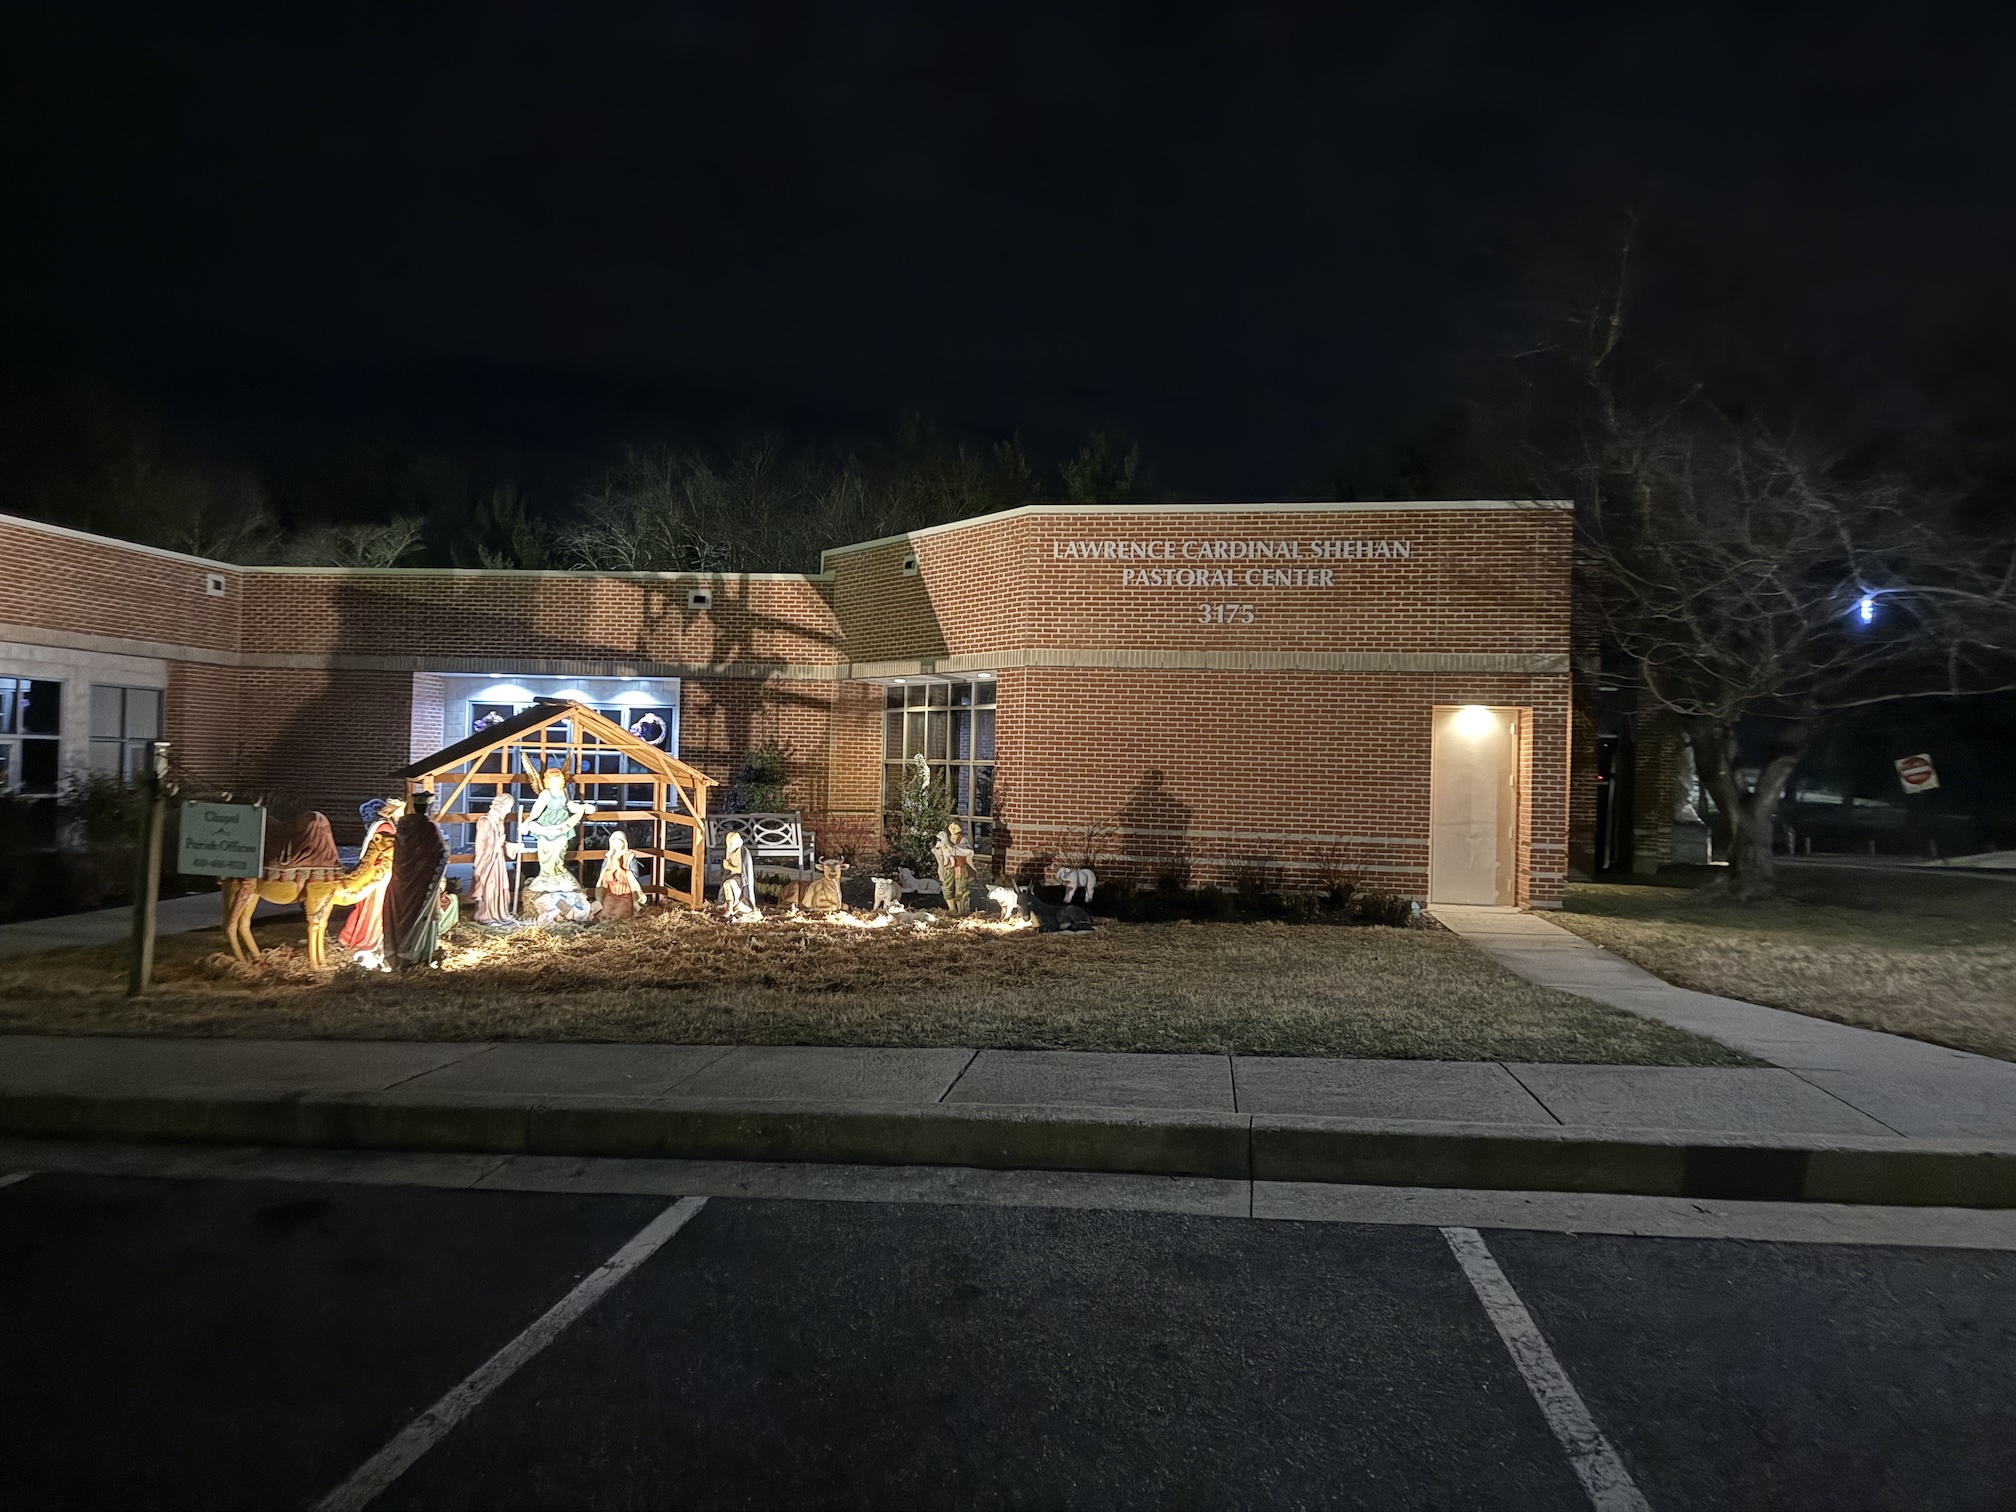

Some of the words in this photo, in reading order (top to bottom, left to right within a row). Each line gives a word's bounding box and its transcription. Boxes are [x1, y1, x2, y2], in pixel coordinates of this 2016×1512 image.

[1053, 541, 1176, 560] LAWRENCE
[1182, 540, 1304, 560] CARDINAL
[1310, 540, 1411, 559] SHEHAN
[1122, 568, 1239, 587] PASTORAL
[1245, 568, 1335, 587] CENTER
[1198, 603, 1255, 624] 3175
